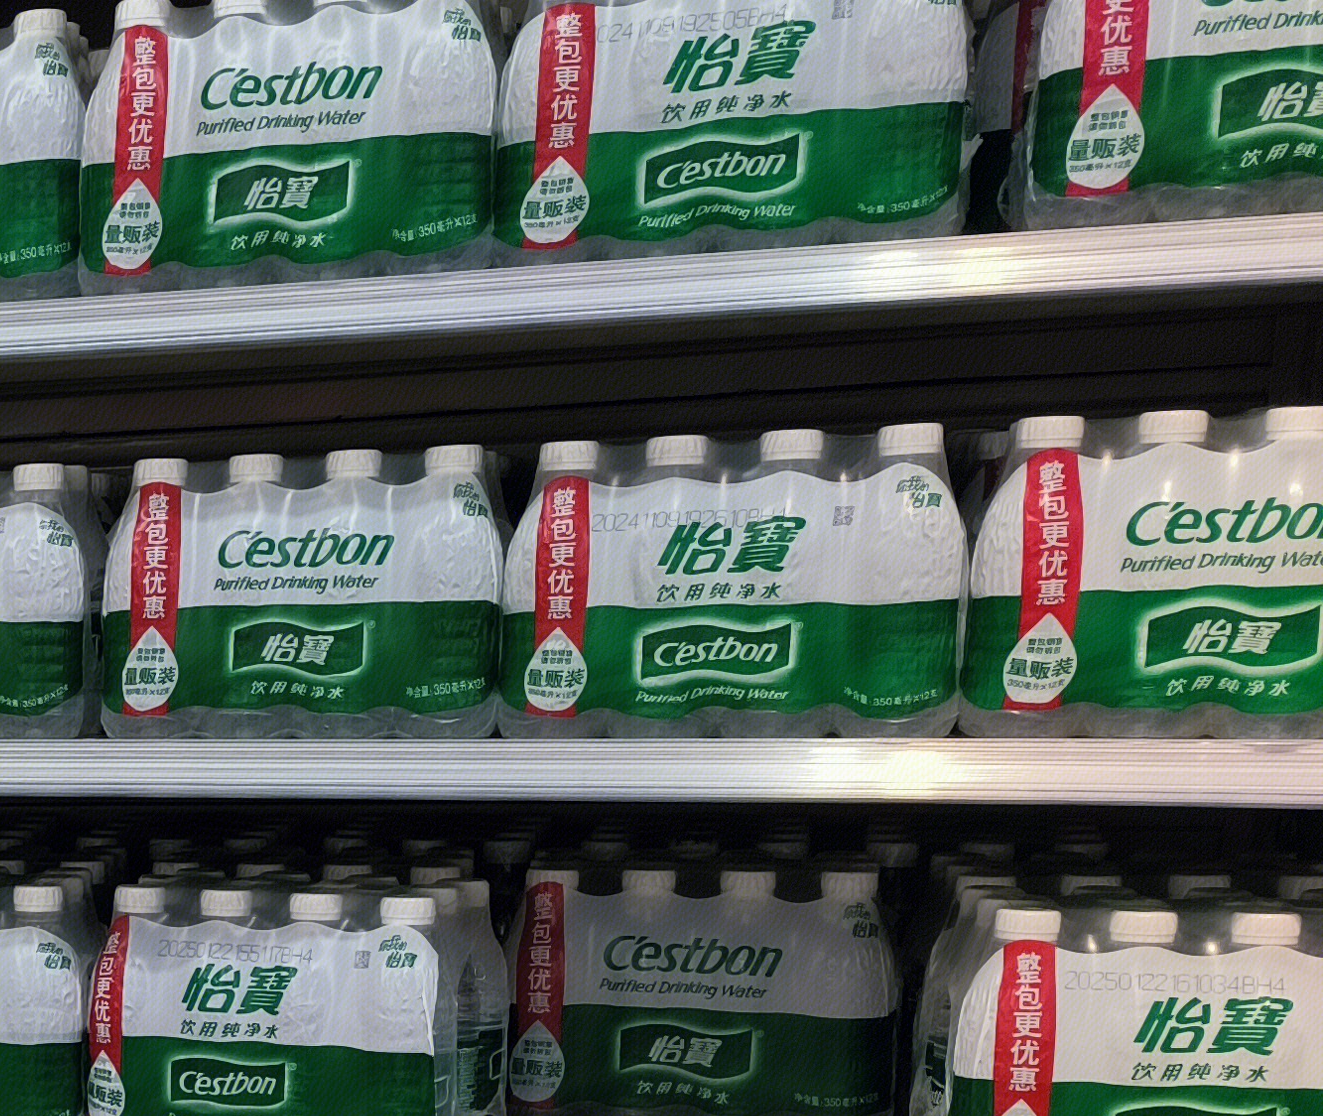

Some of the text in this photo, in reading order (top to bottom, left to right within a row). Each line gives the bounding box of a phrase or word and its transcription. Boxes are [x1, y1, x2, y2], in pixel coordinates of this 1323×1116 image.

[662, 19, 818, 94] 怡寶
[550, 12, 583, 148] 整包更优惠
[128, 36, 156, 172] 整包更优惠
[196, 109, 367, 137] Purified Drinking Water
[245, 175, 319, 210] 怡寶
[105, 221, 160, 243] 量贩装
[230, 231, 327, 249] 饮用纯净水
[1038, 461, 1067, 605] 整包更优惠
[214, 574, 379, 594] Purified Drinking Water
[1183, 619, 1281, 655] 怡寶
[1007, 657, 1074, 679] 量贩装
[182, 965, 297, 1015] 怡寶
[1010, 952, 1041, 1090] 整包更优惠
[1135, 998, 1294, 1054] 怡寶
